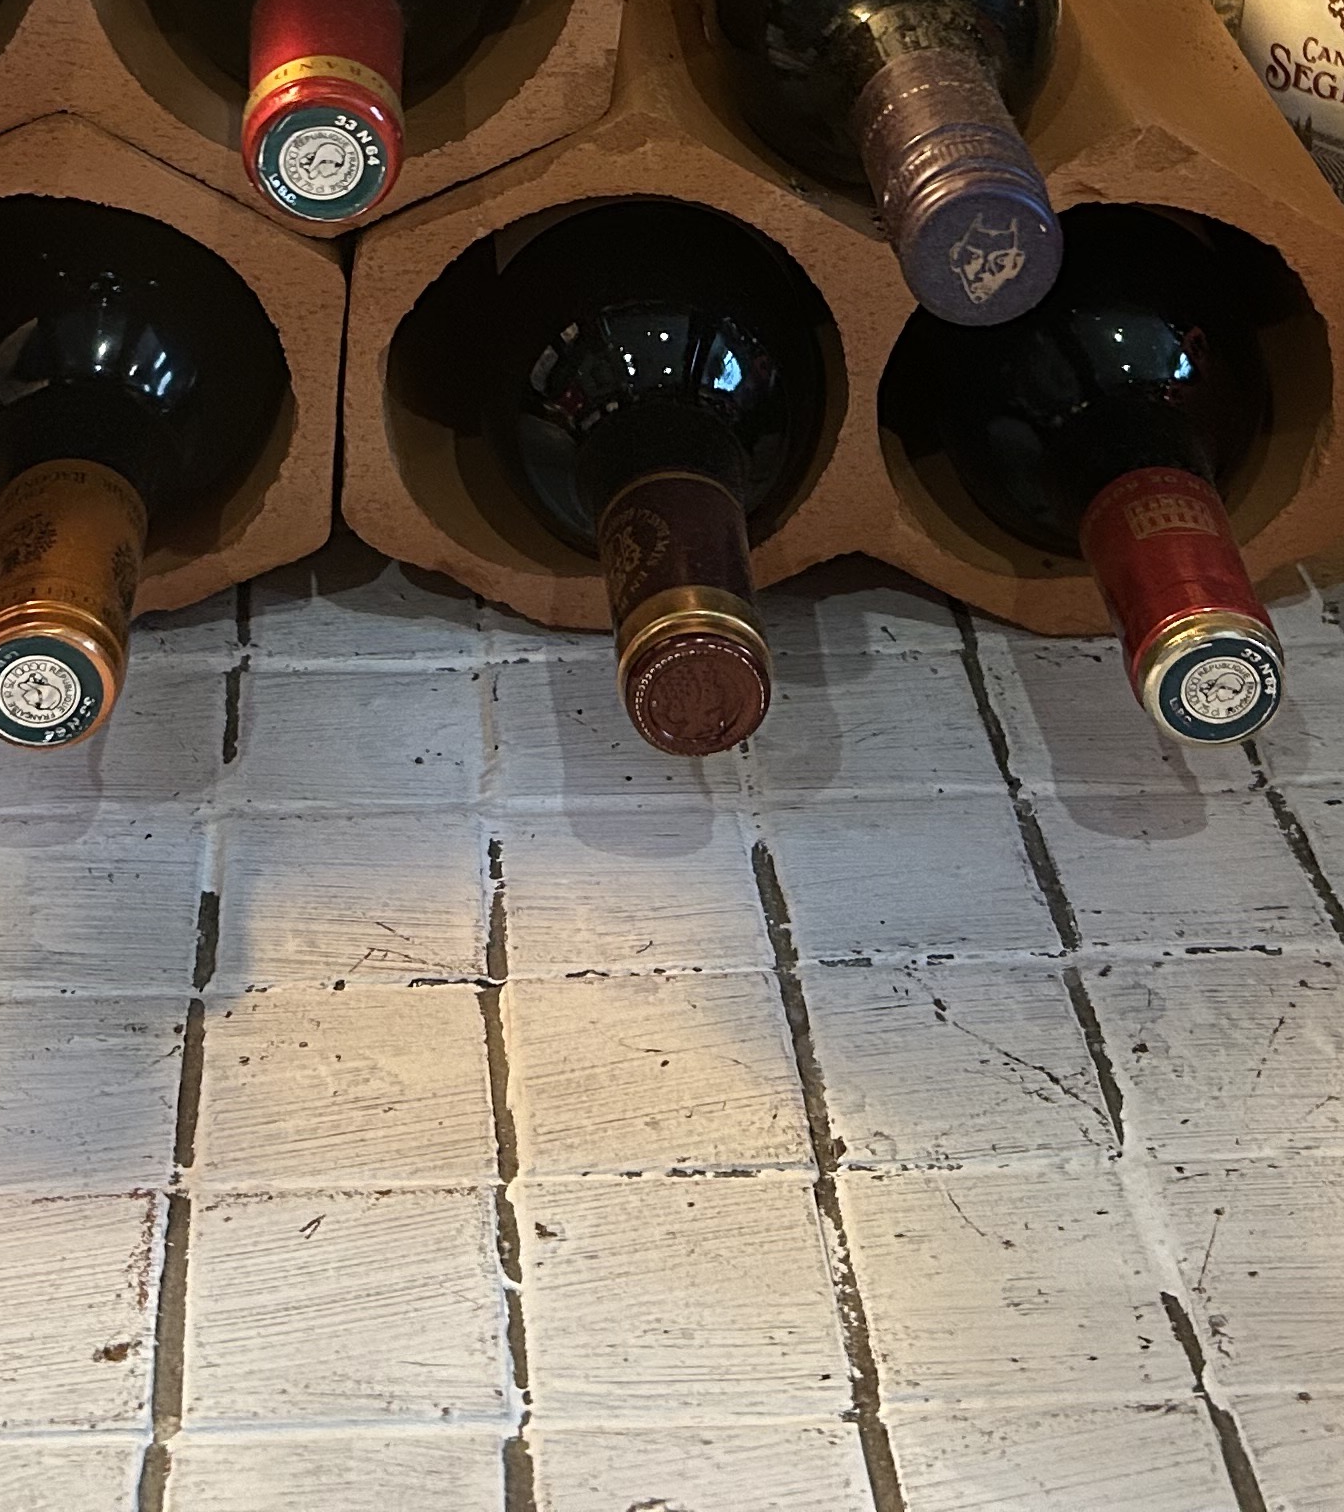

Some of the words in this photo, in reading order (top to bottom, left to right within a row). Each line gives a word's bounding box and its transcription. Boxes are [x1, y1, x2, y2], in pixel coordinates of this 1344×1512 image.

[334, 114, 358, 131] 33
[357, 129, 373, 145] N
[1240, 648, 1262, 663] 33
[1259, 663, 1274, 675] N
